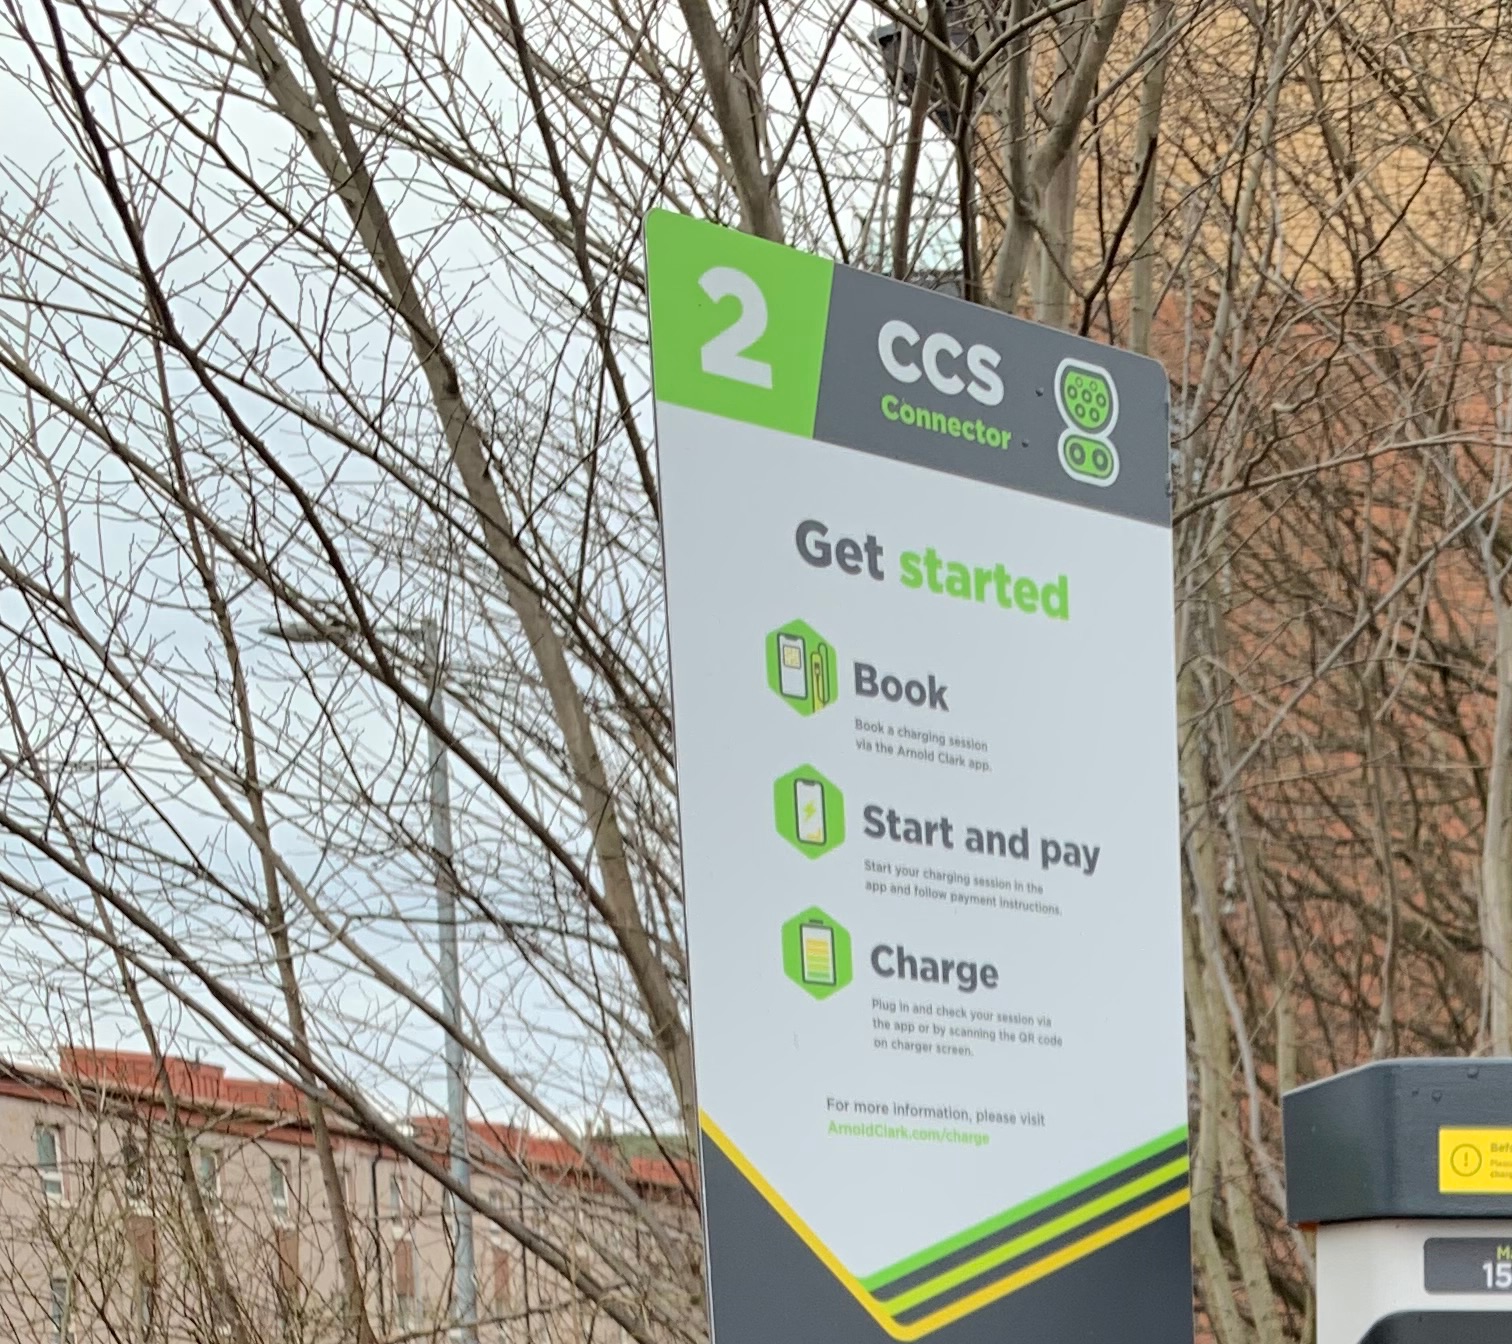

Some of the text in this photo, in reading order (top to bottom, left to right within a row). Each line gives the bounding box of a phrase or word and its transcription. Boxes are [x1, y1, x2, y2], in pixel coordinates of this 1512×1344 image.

[698, 266, 773, 390] 2
[878, 319, 1004, 406] CCS
[881, 394, 1012, 450] Connector
[795, 519, 1069, 620] Get started
[854, 661, 949, 712] Book
[854, 718, 988, 752] Book a charging session
[855, 738, 992, 773] via the Arnold Clark app.
[863, 803, 1101, 877] Start and pay
[863, 859, 1044, 896] Start your charging session in the
[865, 879, 1063, 917] app and follow payment instructions.
[870, 943, 1000, 994] Charge
[872, 998, 1052, 1028] Plug in and check your session via
[872, 1017, 1063, 1047] the app or by scanning the QR code
[873, 1039, 888, 1049] on
[891, 1038, 933, 1054] charger
[826, 1097, 1046, 1127] For more information, please visit
[827, 1119, 990, 1147] ArnoldClark.com/charge
